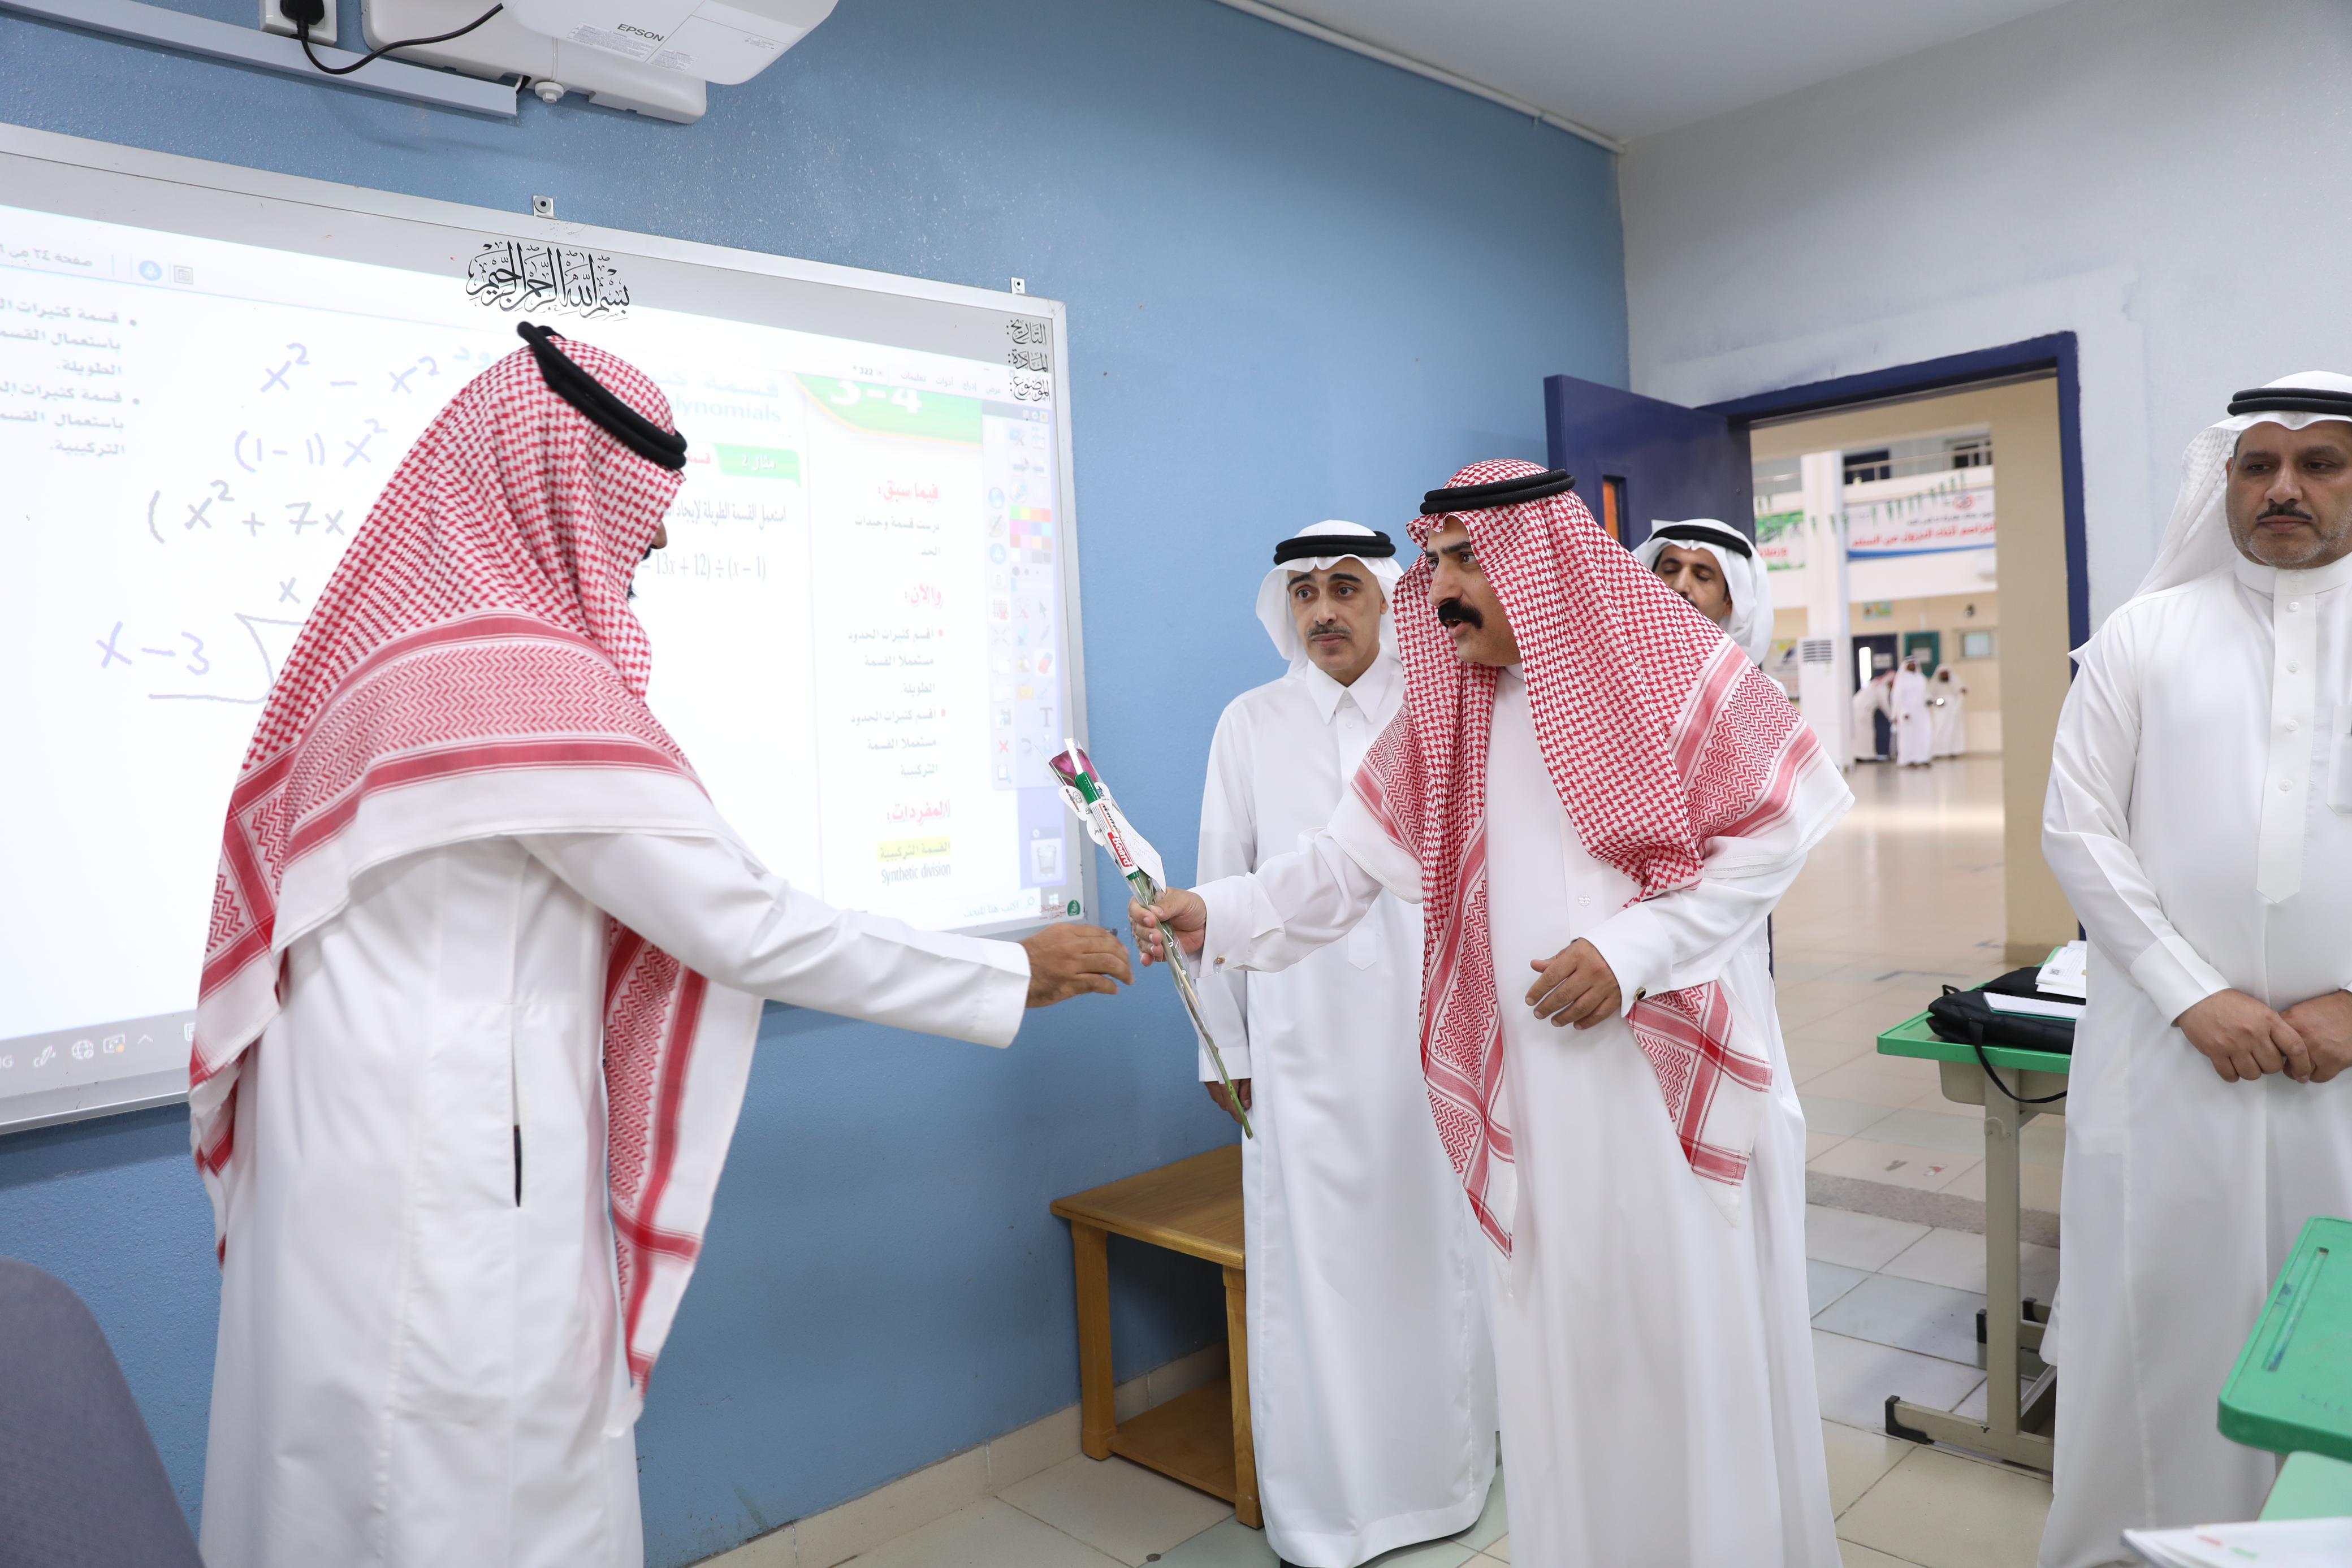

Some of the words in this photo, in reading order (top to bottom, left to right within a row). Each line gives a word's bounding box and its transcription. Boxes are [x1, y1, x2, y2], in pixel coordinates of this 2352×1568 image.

[617, 23, 664, 41] EPSON
[54, 253, 92, 266] صفحة
[17, 301, 71, 319] كثيرات
[77, 307, 119, 323] قسمة
[51, 332, 120, 353] باستعمال
[20, 384, 74, 402] كثيرات
[81, 389, 122, 403] قسمة
[54, 413, 124, 433] باستعمال
[1111, 835, 1132, 867] Board
[881, 866, 918, 886] Synthetic
[921, 863, 951, 878] division
